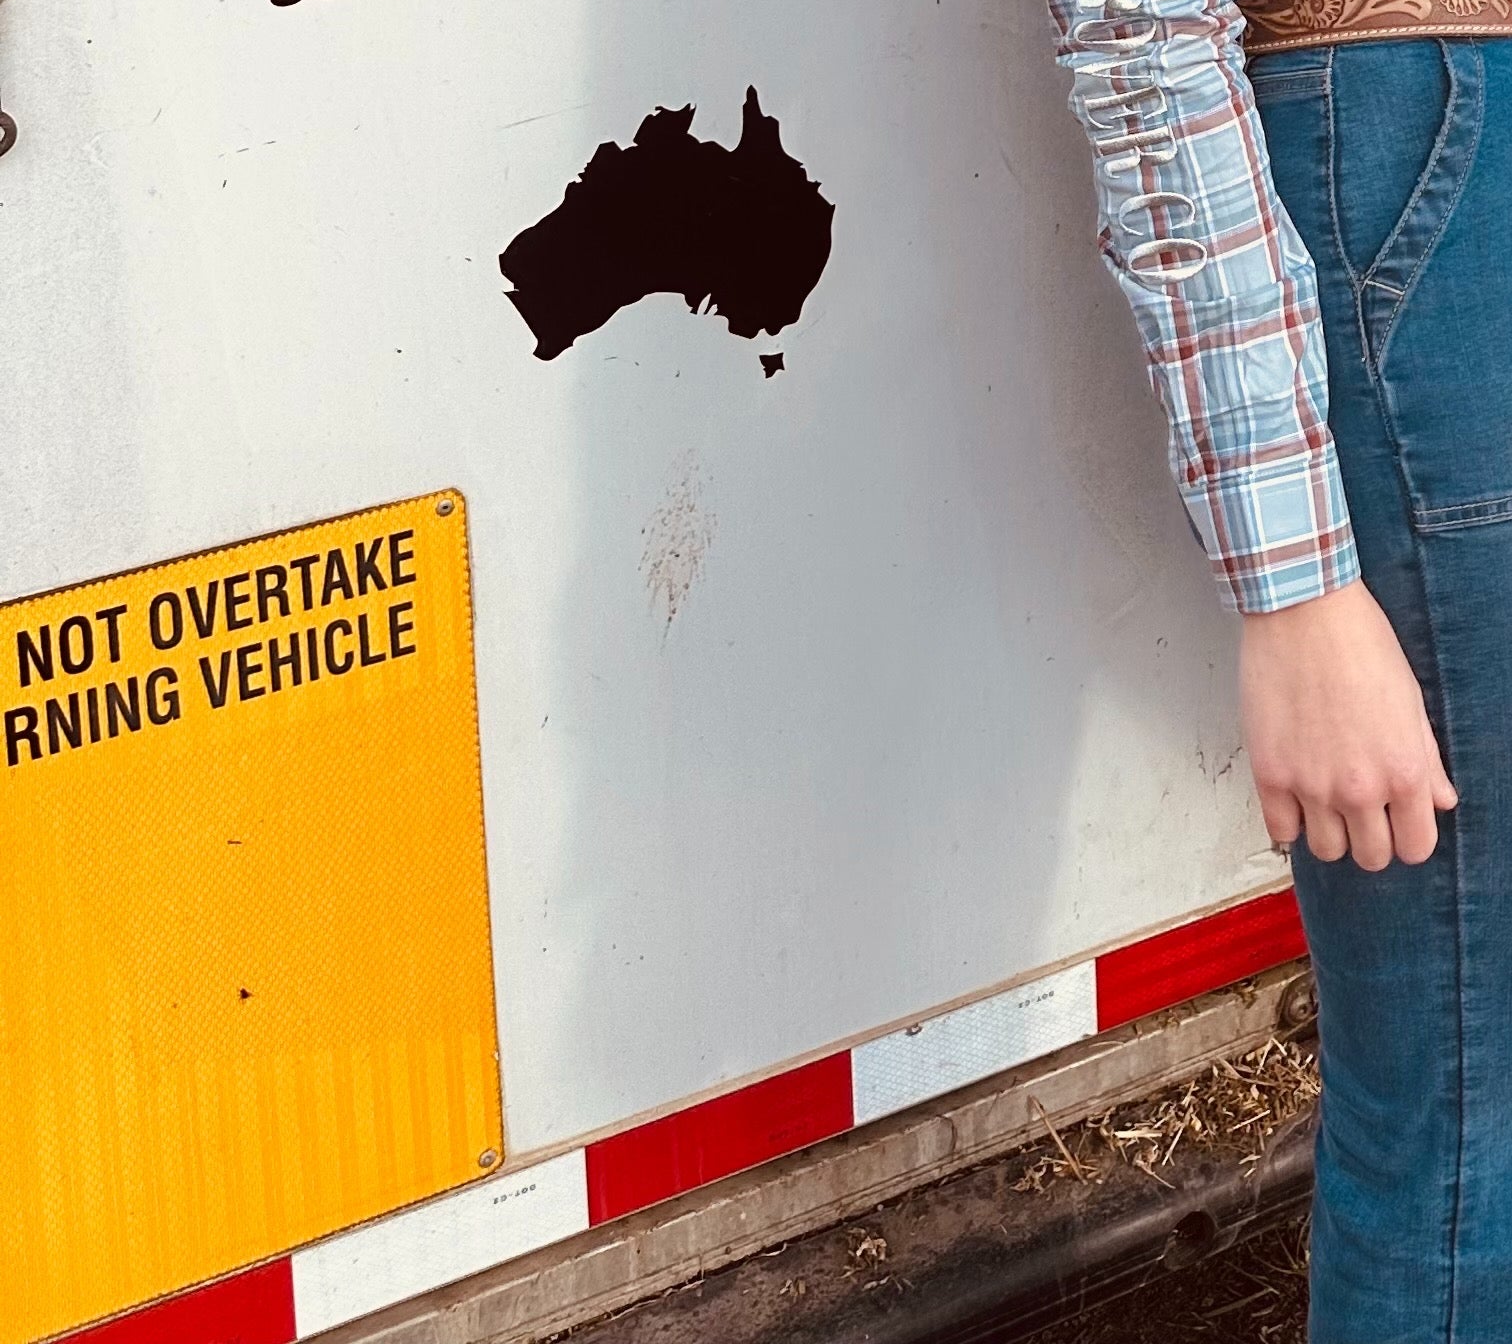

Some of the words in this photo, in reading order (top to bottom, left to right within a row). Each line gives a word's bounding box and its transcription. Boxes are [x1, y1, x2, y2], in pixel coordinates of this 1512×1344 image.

[1118, 191, 1208, 286] CO
[4, 667, 181, 767] RNING
[198, 601, 416, 709] VEHICLE
[16, 604, 127, 688] NOT
[149, 529, 417, 651] OVERTAKE
